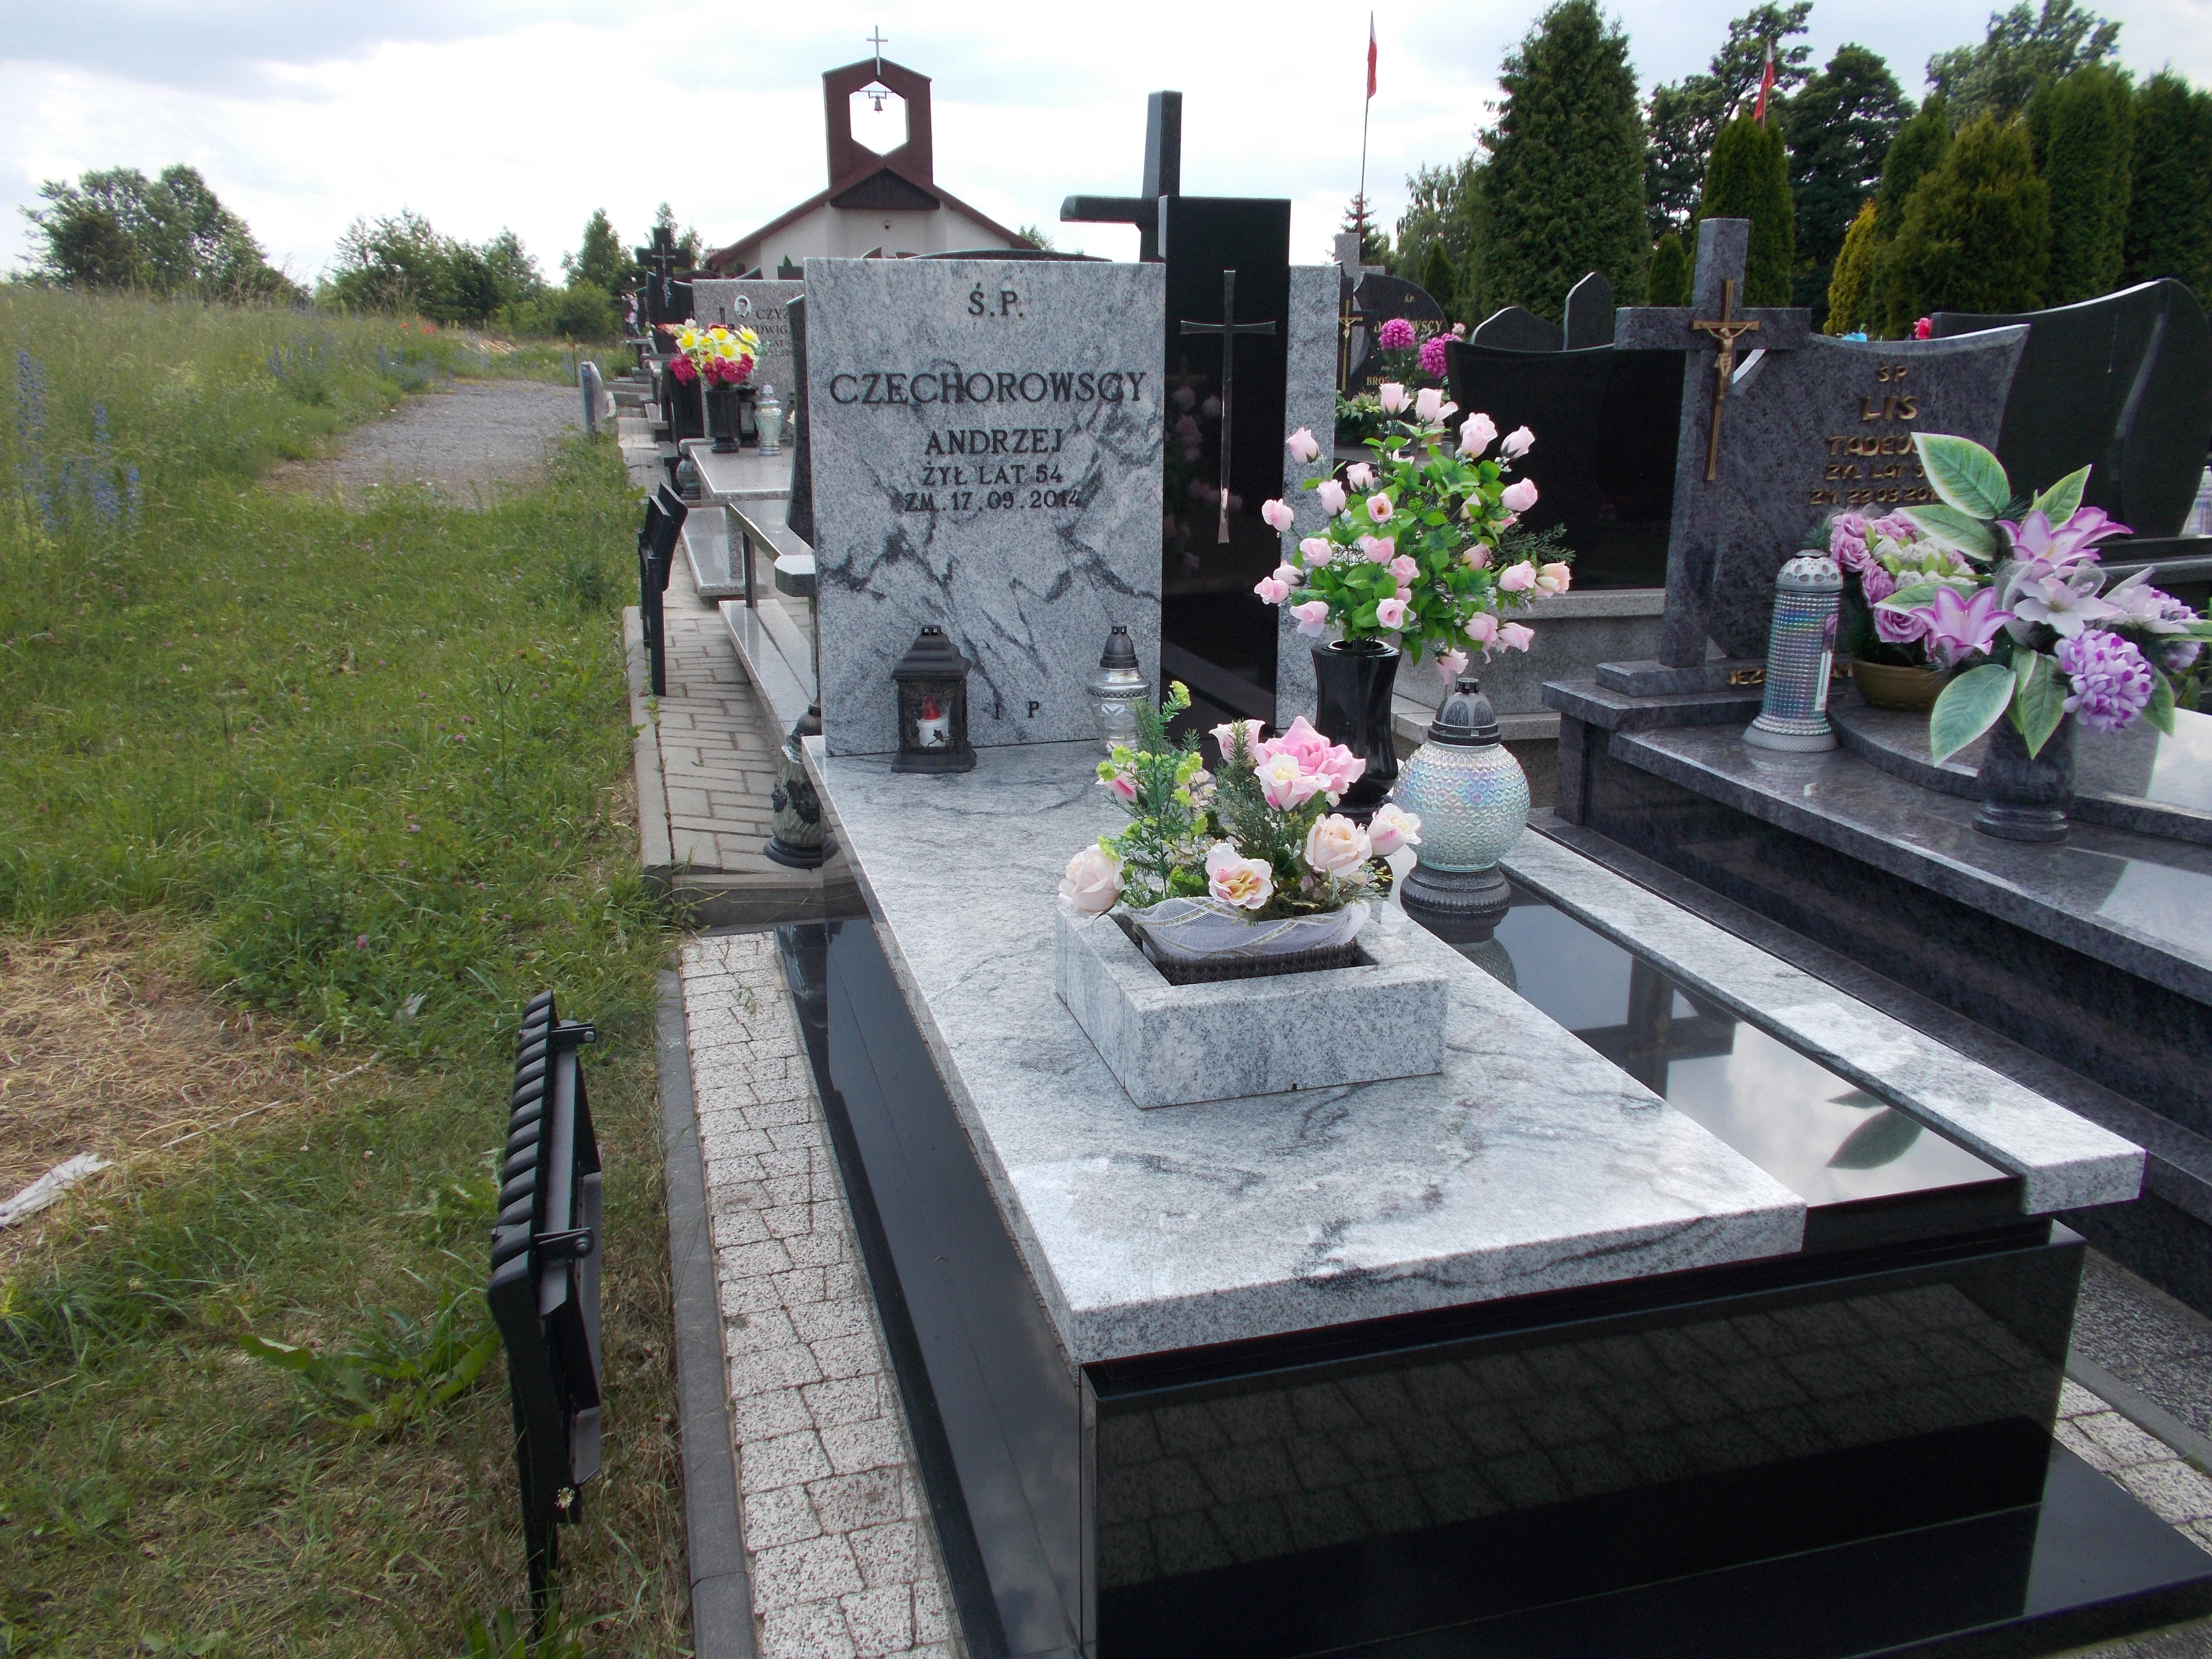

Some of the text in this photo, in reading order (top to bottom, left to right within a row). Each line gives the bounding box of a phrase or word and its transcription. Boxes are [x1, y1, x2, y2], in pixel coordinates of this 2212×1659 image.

[968, 283, 1024, 317] Ś.P.
[1860, 395, 1918, 421] LIS
[924, 428, 1063, 455] ANDRZEJ
[922, 461, 1063, 486] ŻYŁ LAT 54
[1726, 668, 1767, 685] JEZ
